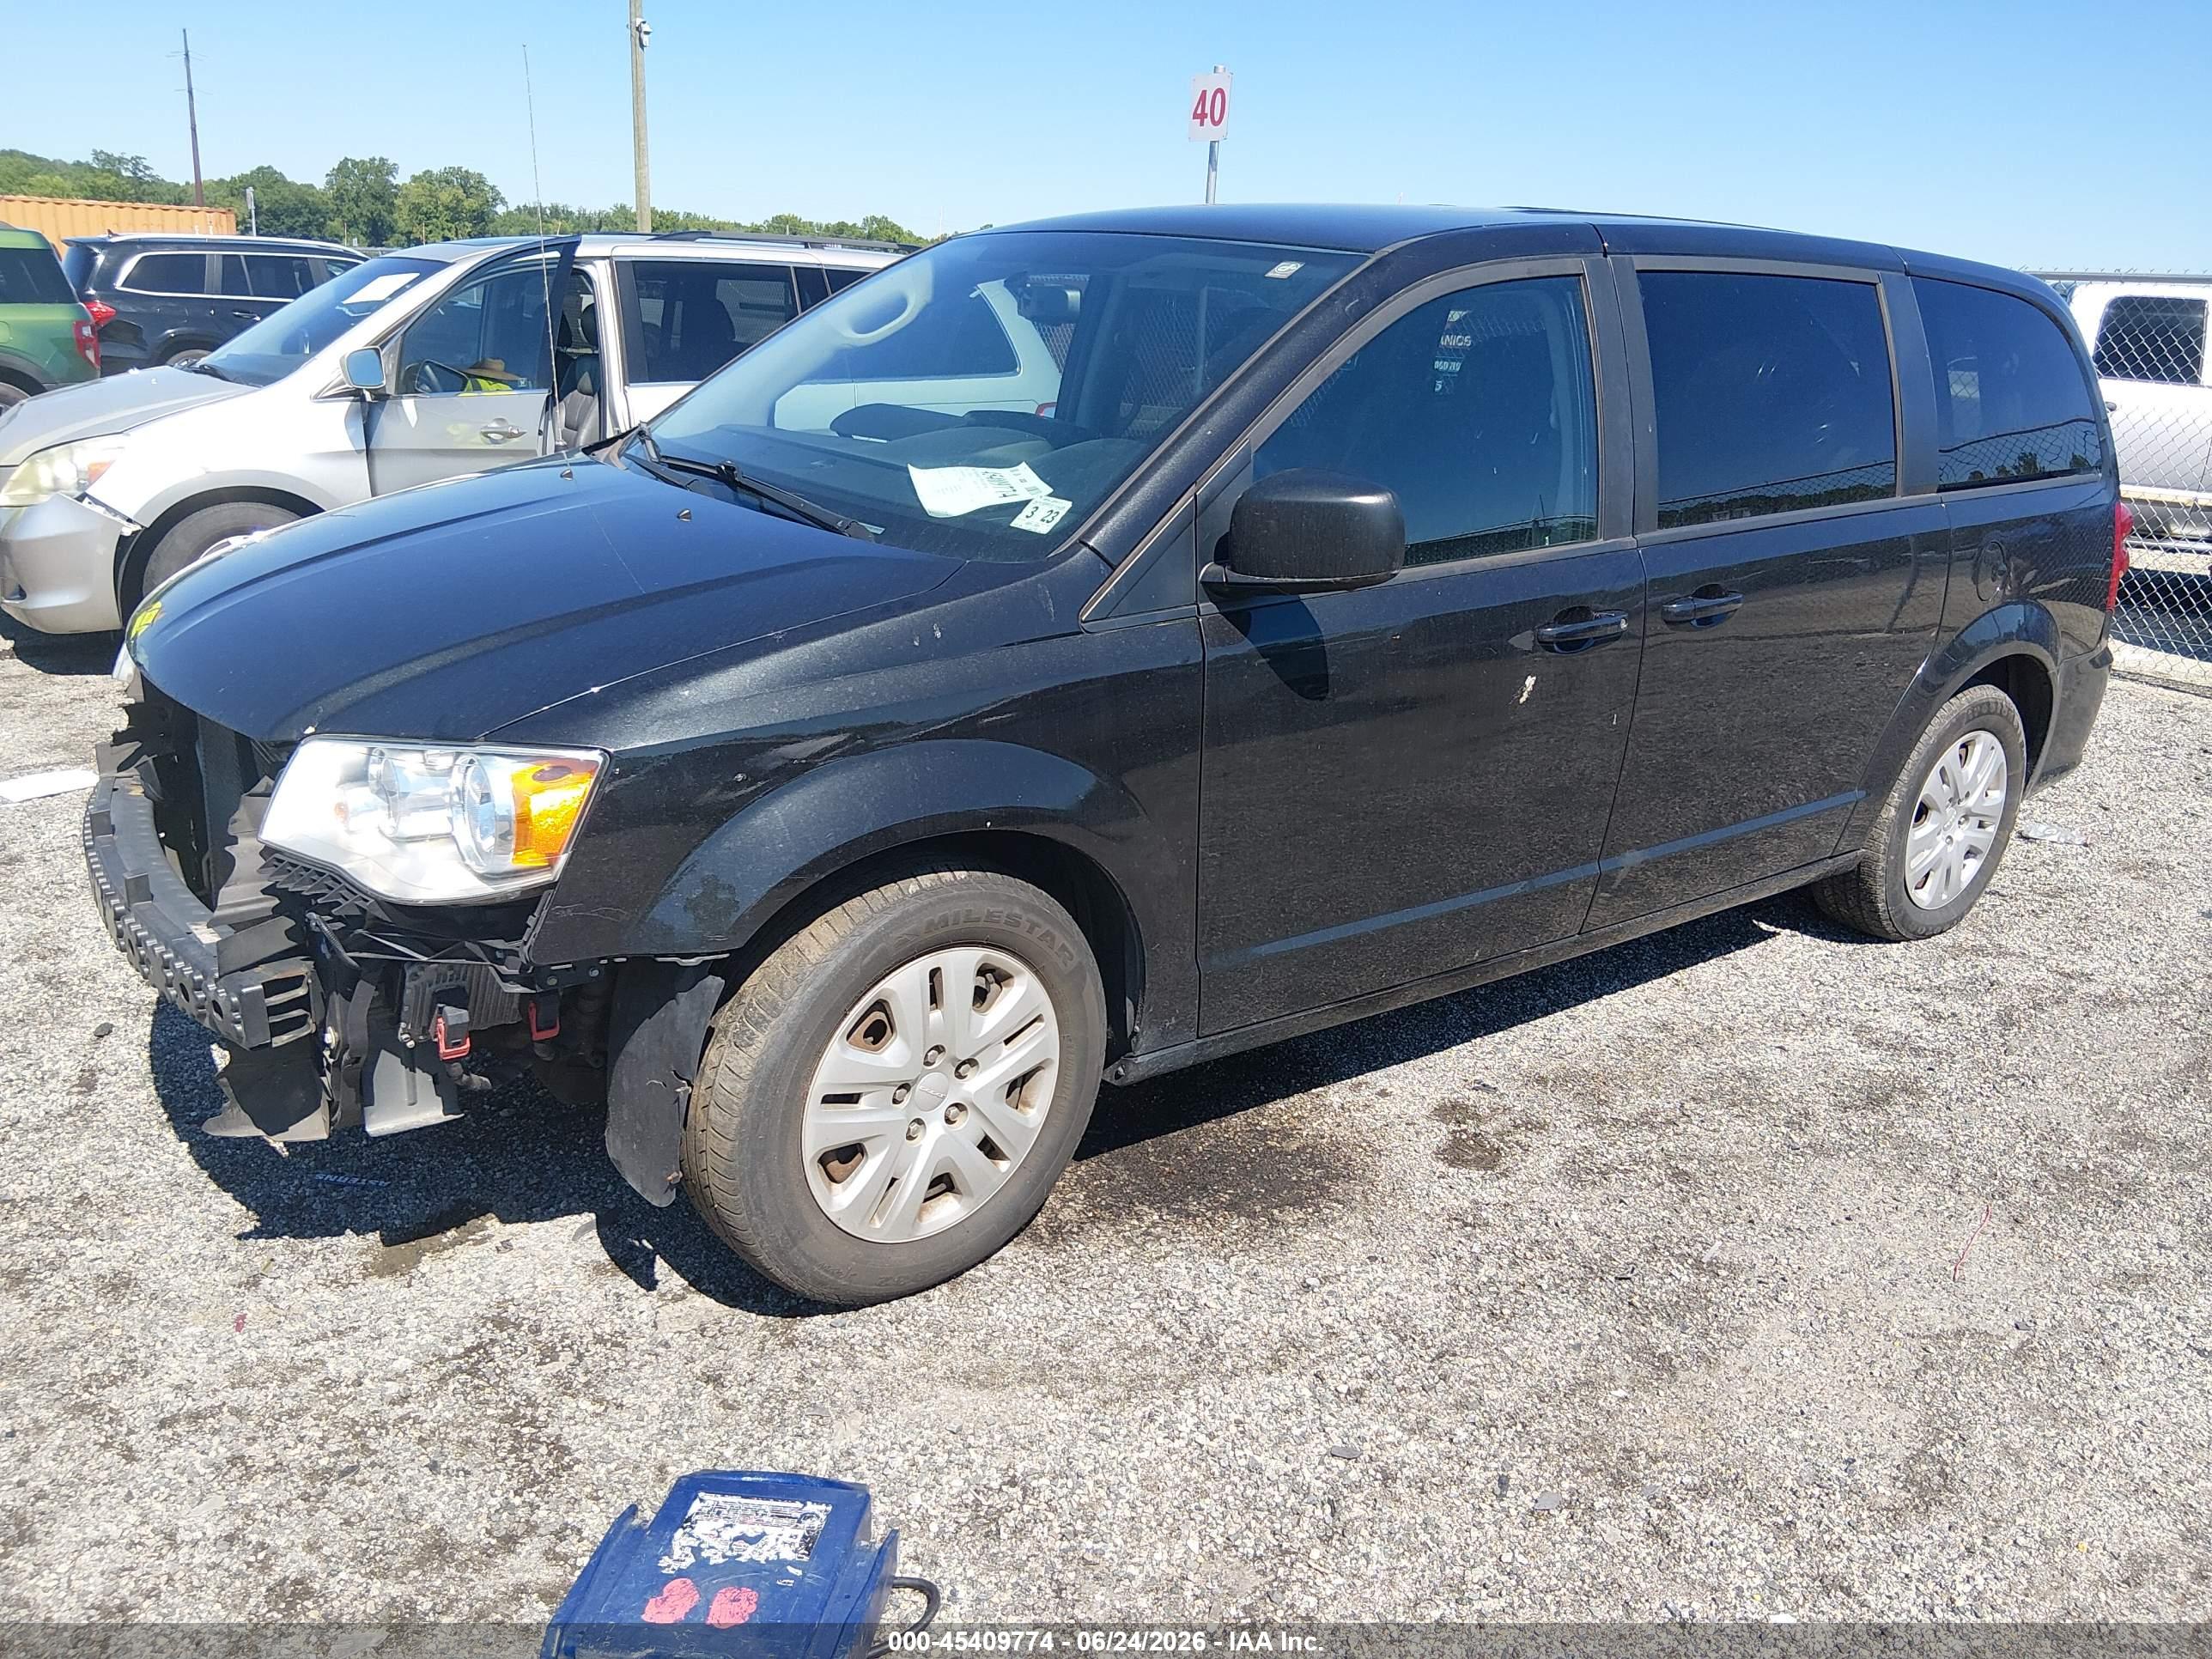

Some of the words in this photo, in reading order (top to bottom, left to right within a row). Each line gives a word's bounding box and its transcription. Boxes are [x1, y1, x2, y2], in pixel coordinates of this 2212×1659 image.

[1192, 87, 1227, 127] 40
[1025, 506, 1039, 519] 3
[1040, 509, 1060, 524] 23
[923, 907, 1077, 972] MILESTAR
